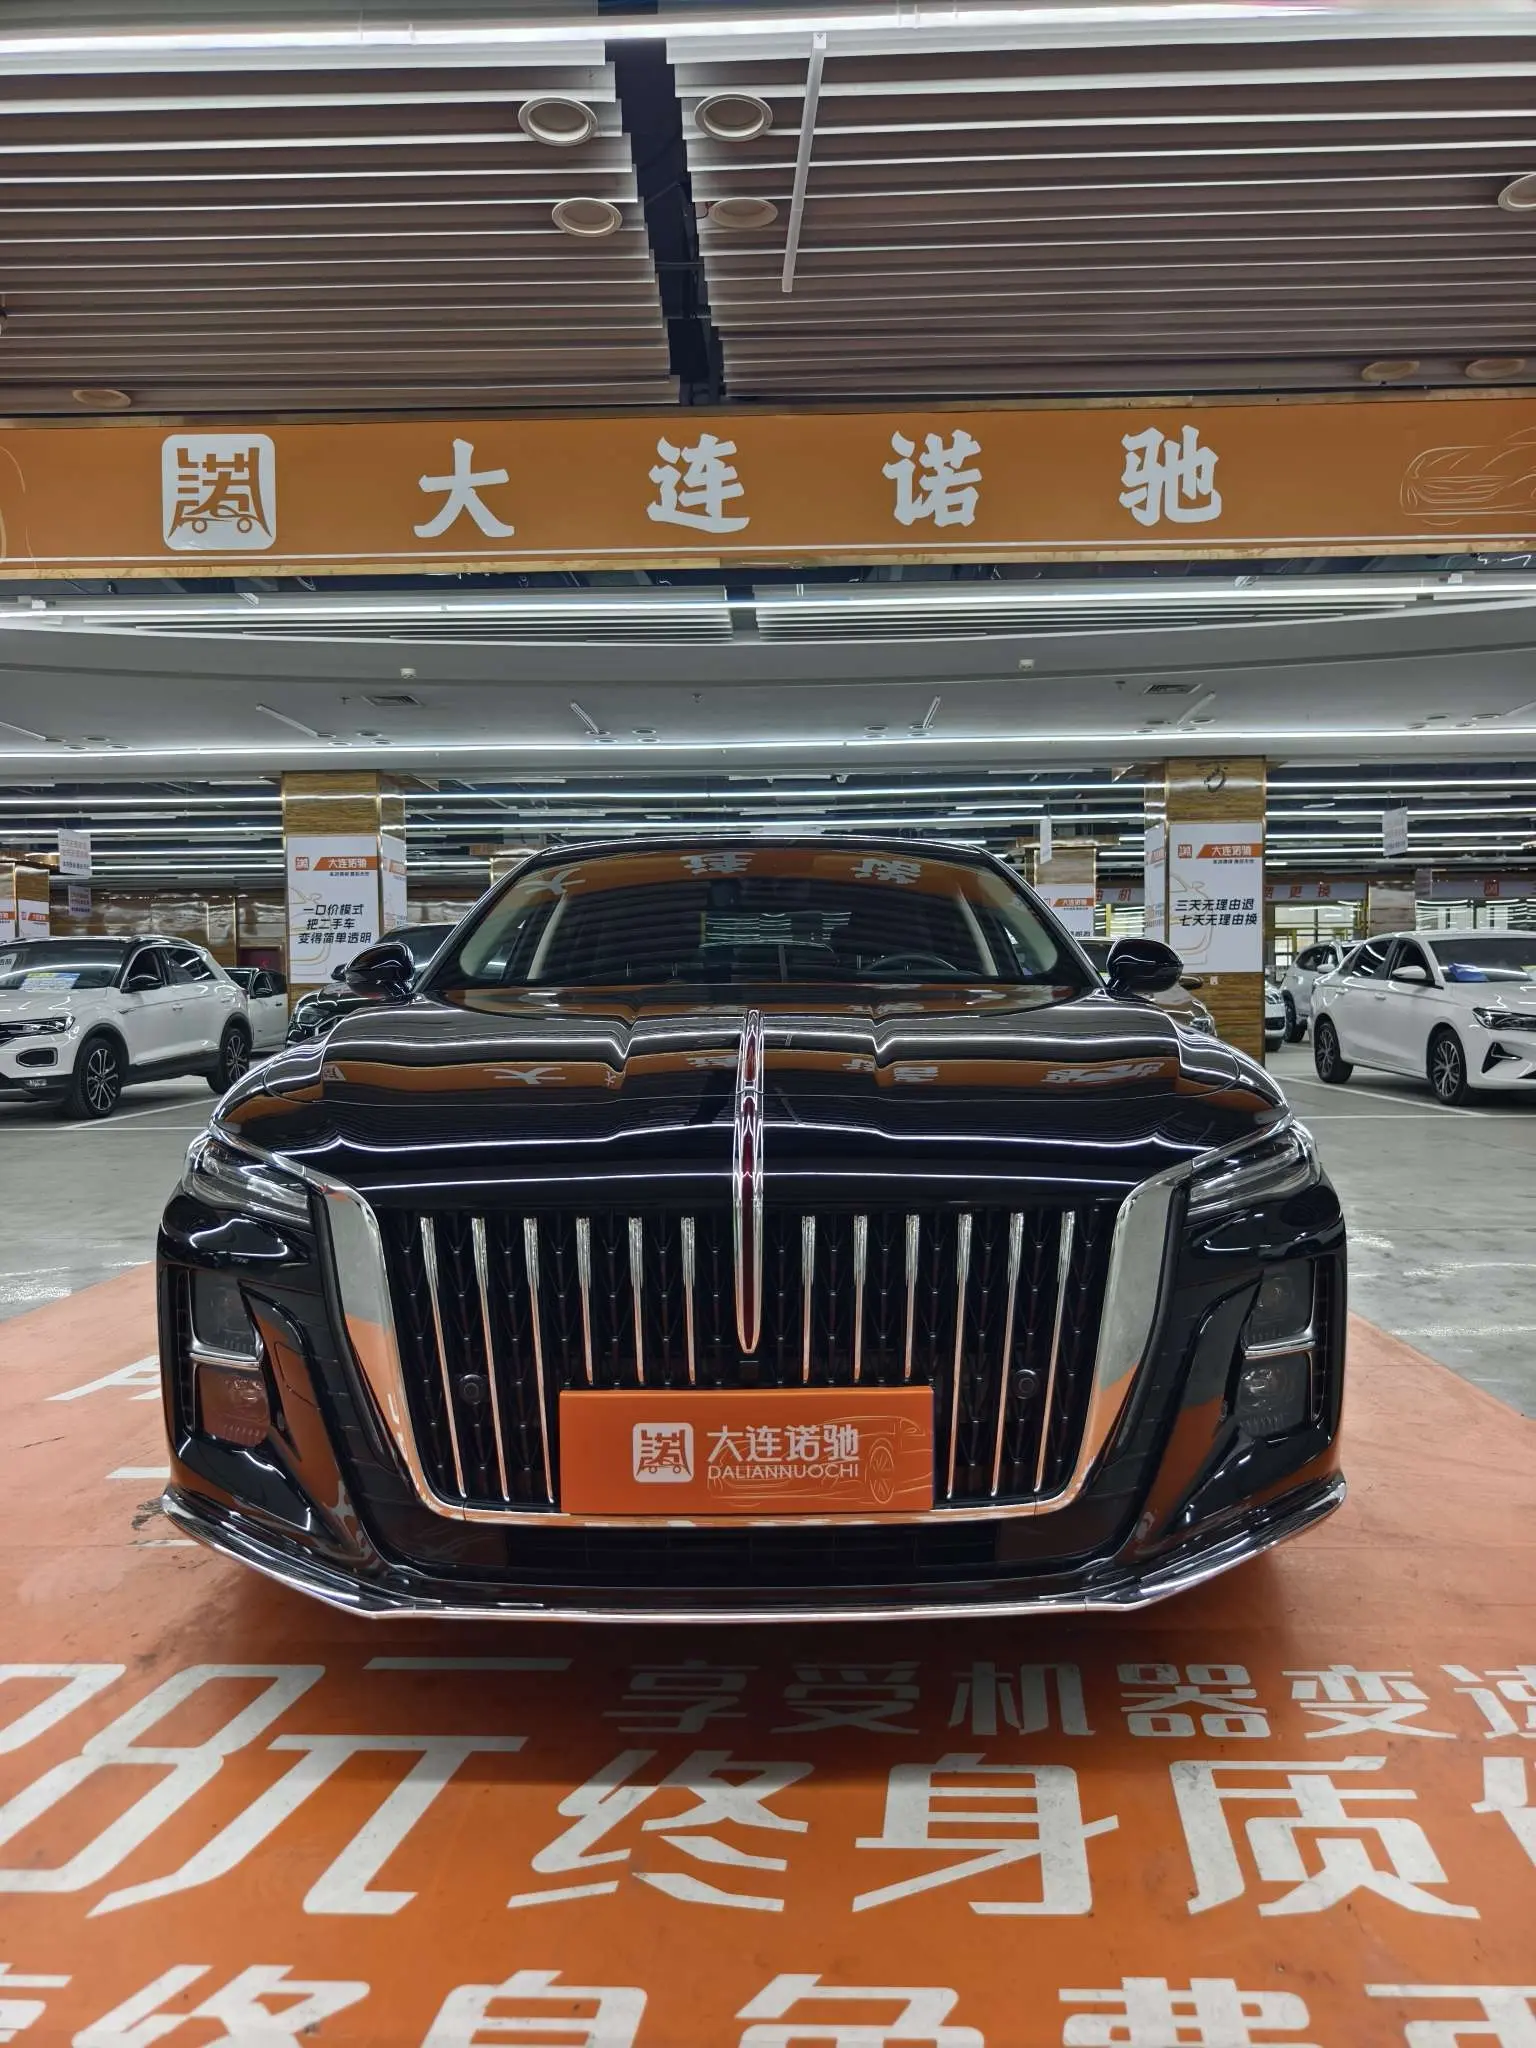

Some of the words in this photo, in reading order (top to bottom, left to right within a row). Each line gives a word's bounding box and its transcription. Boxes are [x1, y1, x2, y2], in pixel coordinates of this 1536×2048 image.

[413, 424, 1223, 539] 大连诺驰
[303, 903, 364, 916] 一口价模式
[1175, 898, 1254, 911] 三天无理由退
[306, 918, 355, 930] 把二手车
[1180, 913, 1258, 926] 七天无理由换
[707, 1424, 860, 1462] 大连诺驰
[708, 1463, 860, 1479] DALIANNUOCHI
